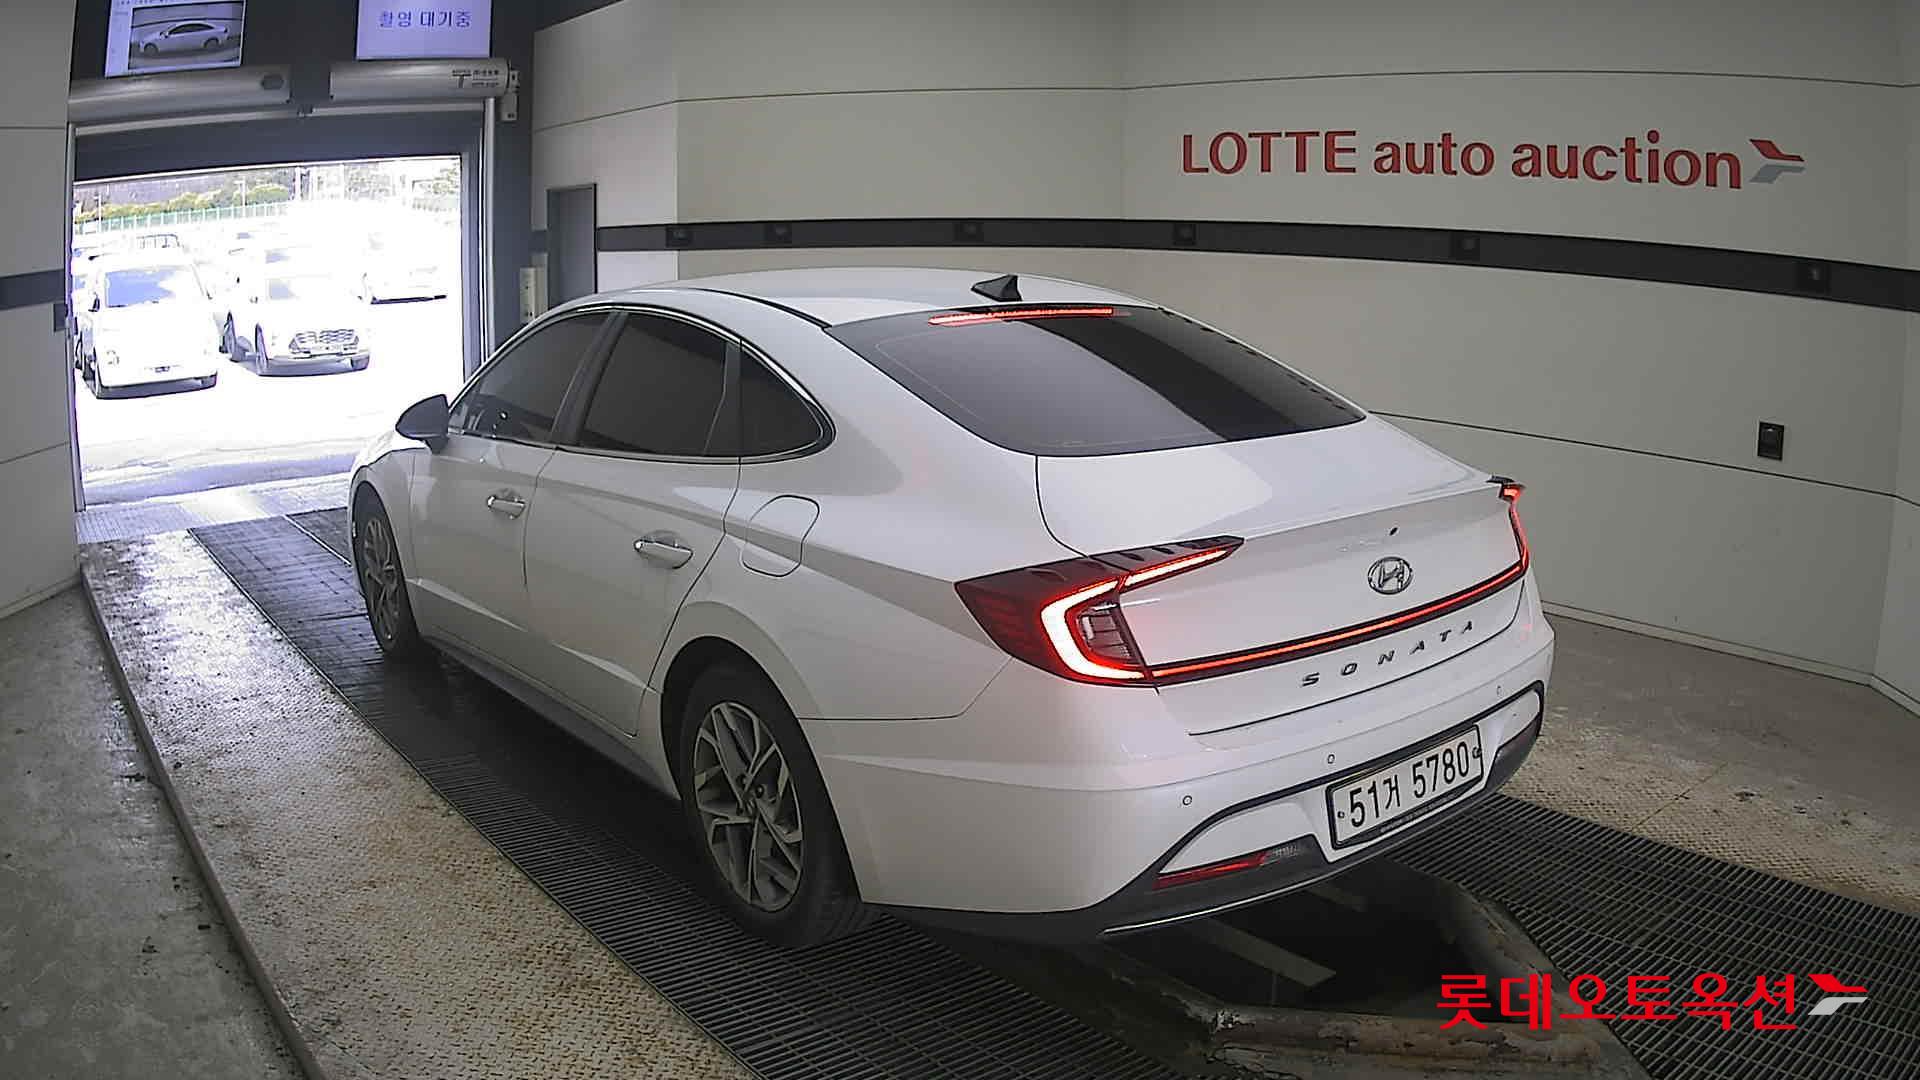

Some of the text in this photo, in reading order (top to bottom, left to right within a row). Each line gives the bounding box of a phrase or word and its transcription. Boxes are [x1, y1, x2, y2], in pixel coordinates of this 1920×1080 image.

[420, 11, 471, 27] 대기중
[1183, 129, 1743, 189] LOTTE auto auction
[1302, 620, 1473, 687] SONATA
[1349, 774, 1400, 828] 51거
[1412, 741, 1470, 798] 5780
